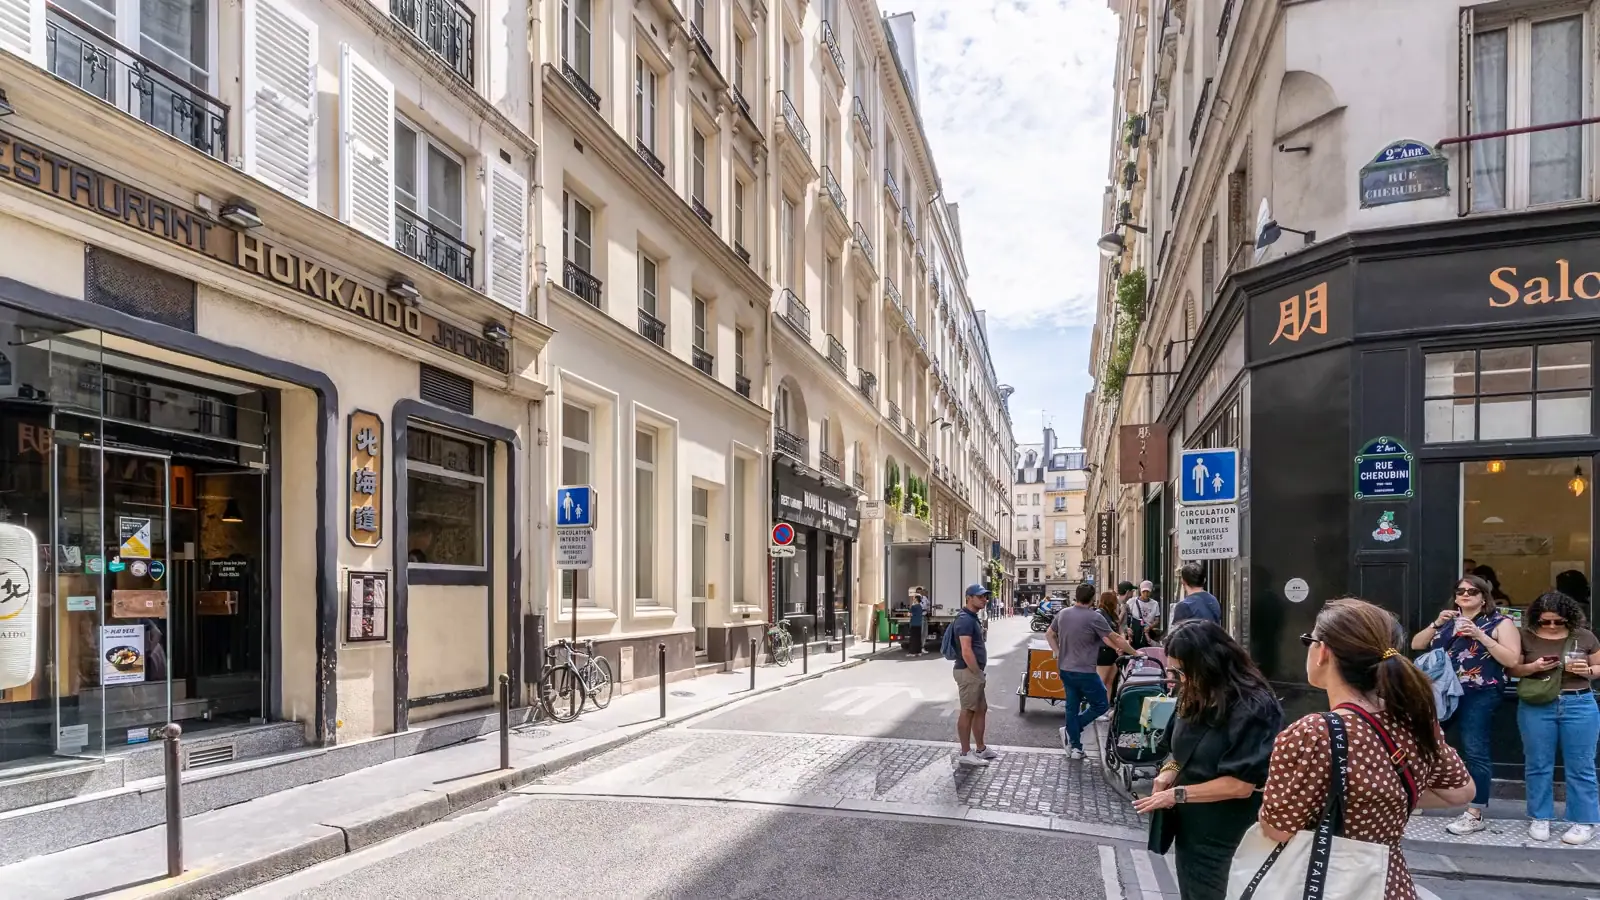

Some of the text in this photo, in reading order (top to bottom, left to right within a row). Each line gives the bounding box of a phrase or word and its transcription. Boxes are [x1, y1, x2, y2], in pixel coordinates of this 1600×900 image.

[1388, 170, 1417, 183] RUE
[236, 232, 422, 337] HOKKAIDO
[1269, 281, 1328, 345] 朋
[1375, 461, 1393, 470] RUE
[1360, 470, 1409, 480] CHERUBINI
[1180, 507, 1236, 517] CIRCULATION
[1186, 517, 1230, 525] INTERDITE
